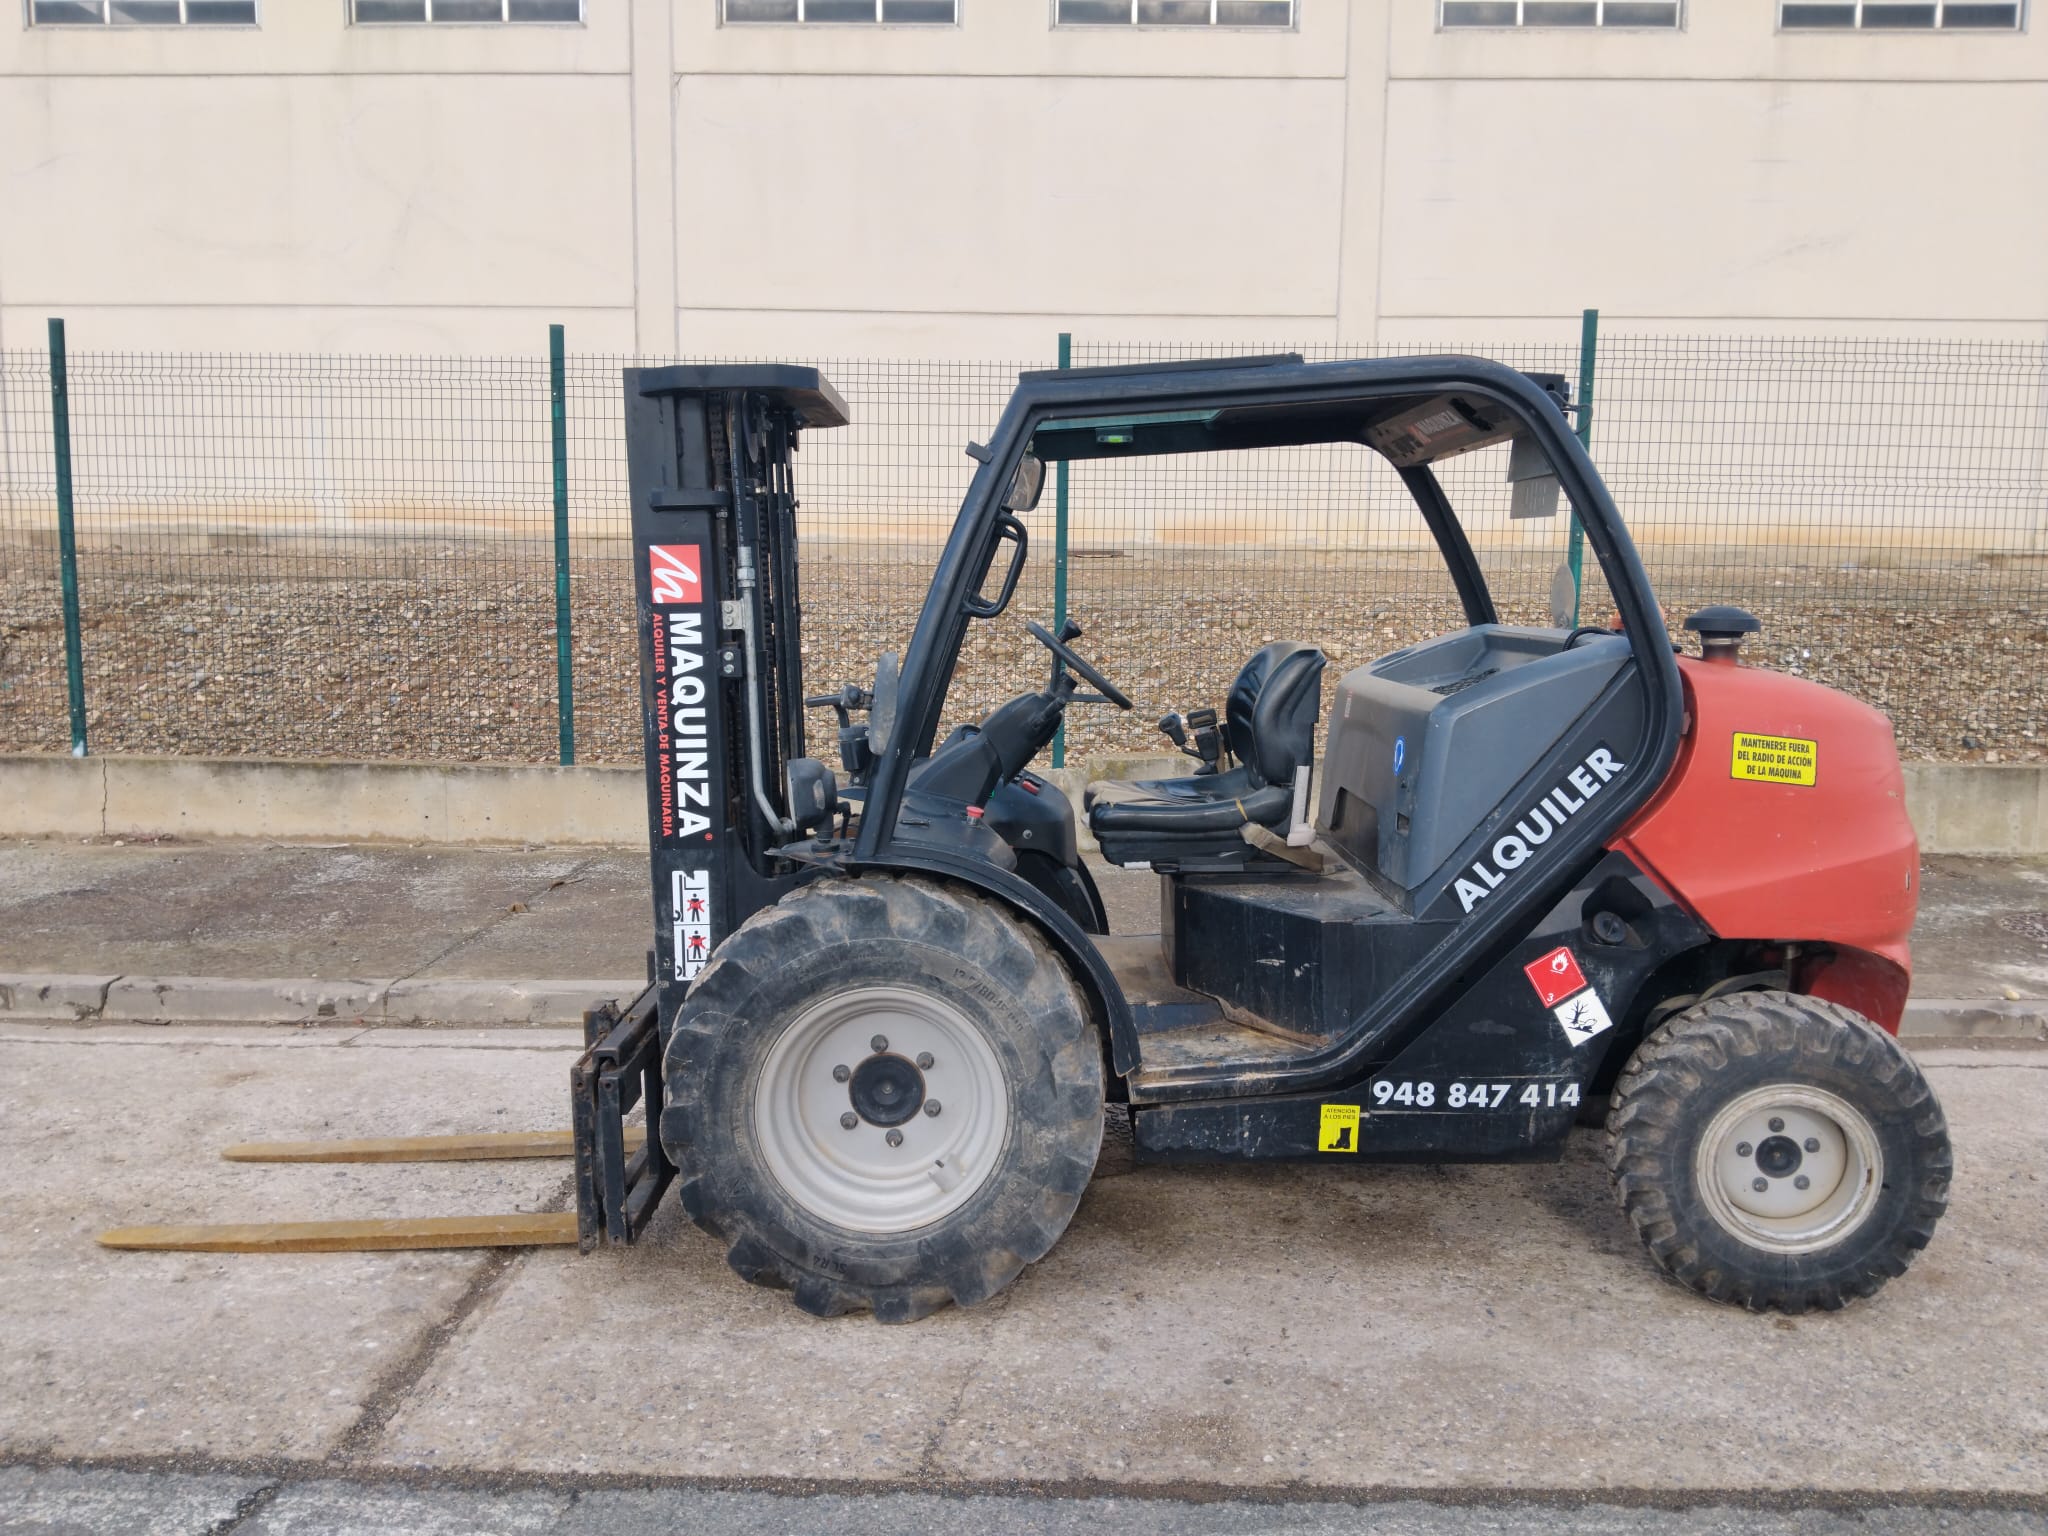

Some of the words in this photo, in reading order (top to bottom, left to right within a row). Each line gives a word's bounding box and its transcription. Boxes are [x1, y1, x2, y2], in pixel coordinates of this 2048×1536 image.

[653, 613, 665, 672] ALQUILER
[658, 690, 667, 731] VENTA
[669, 613, 711, 838] MAQUINZA
[659, 733, 669, 749] DE
[1741, 737, 1787, 752] MANTENERSE
[1788, 742, 1810, 754] FUERA
[1737, 750, 1750, 761] DEL
[1752, 752, 1774, 764] RADIO
[1776, 754, 1785, 765] DE
[1746, 765, 1755, 774] DE
[1758, 766, 1766, 776] LA
[660, 753, 672, 837] MAQUINARIA
[1454, 748, 1625, 914] ALQUILER
[1547, 993, 1555, 1002] 3
[1373, 1080, 1435, 1106] 948
[1448, 1082, 1512, 1108] 847
[1519, 1083, 1581, 1107] 414
